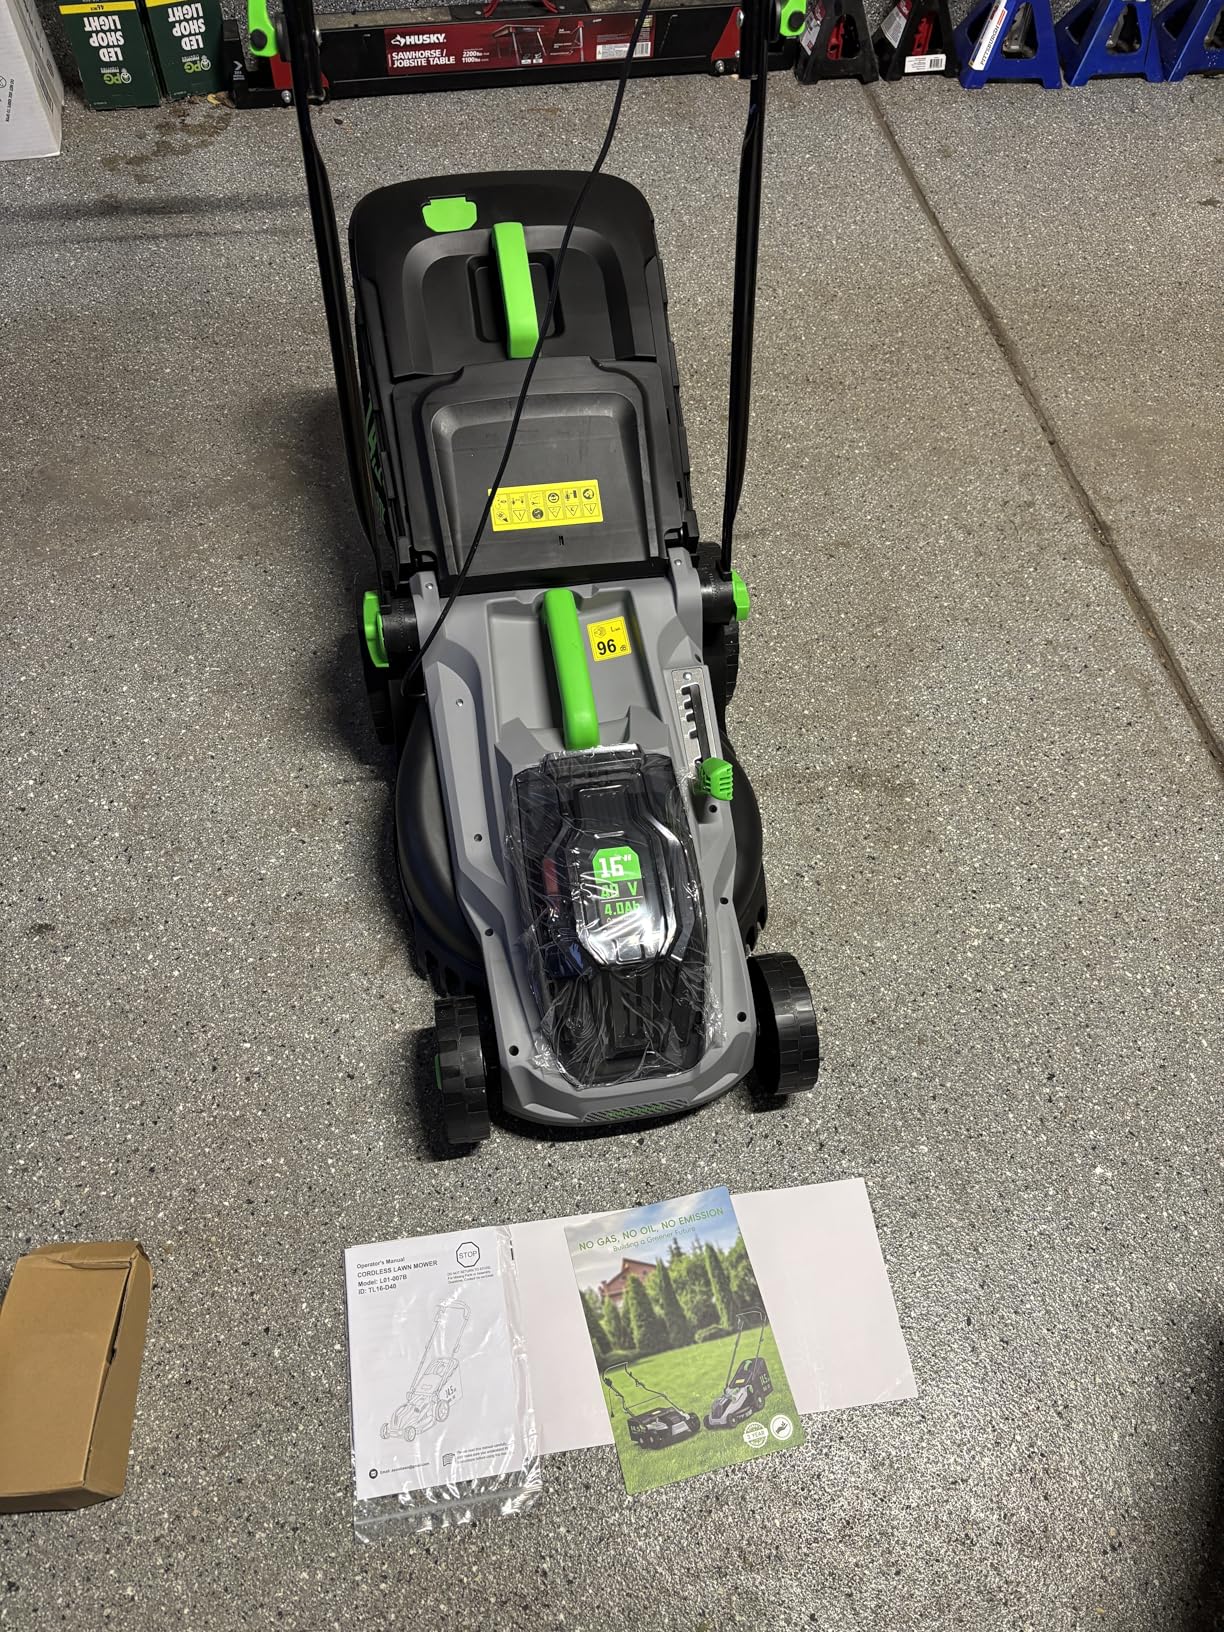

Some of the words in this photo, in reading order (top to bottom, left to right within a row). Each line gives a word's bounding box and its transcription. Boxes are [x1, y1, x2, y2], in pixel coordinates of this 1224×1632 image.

[168, 3, 204, 22] LIGHT
[83, 16, 121, 32] LIGHT
[172, 18, 206, 37] SHOP
[89, 31, 124, 47] SHOP
[181, 36, 204, 51] LED
[406, 34, 446, 44] HUSKY
[980, 25, 1000, 65] PITTSBURGH
[99, 47, 123, 62] LED
[392, 50, 441, 60] SAWHORSE
[393, 58, 427, 68] JOBSITE
[428, 56, 456, 65] TABLE
[597, 639, 616, 655] 96
[627, 882, 638, 896] V
[578, 1240, 594, 1251] NO
[597, 1234, 620, 1247] GAS,
[622, 1229, 637, 1240] NO
[640, 1225, 659, 1235] OIL,
[661, 1219, 676, 1229] NO
[679, 1208, 724, 1224] EMISSION
[613, 1241, 639, 1252] Building
[647, 1232, 673, 1243] Greener
[675, 1226, 696, 1236] Future
[459, 1251, 477, 1259] STOP
[357, 1260, 385, 1269] Operator's
[357, 1267, 392, 1278] CORDLESS
[393, 1264, 412, 1272] LAWN
[414, 1260, 438, 1269] MOWER
[358, 1279, 378, 1287] Model:
[379, 1274, 407, 1283] L01-007B
[368, 1283, 397, 1293] TL16-D40
[752, 1430, 765, 1438] YEAR
